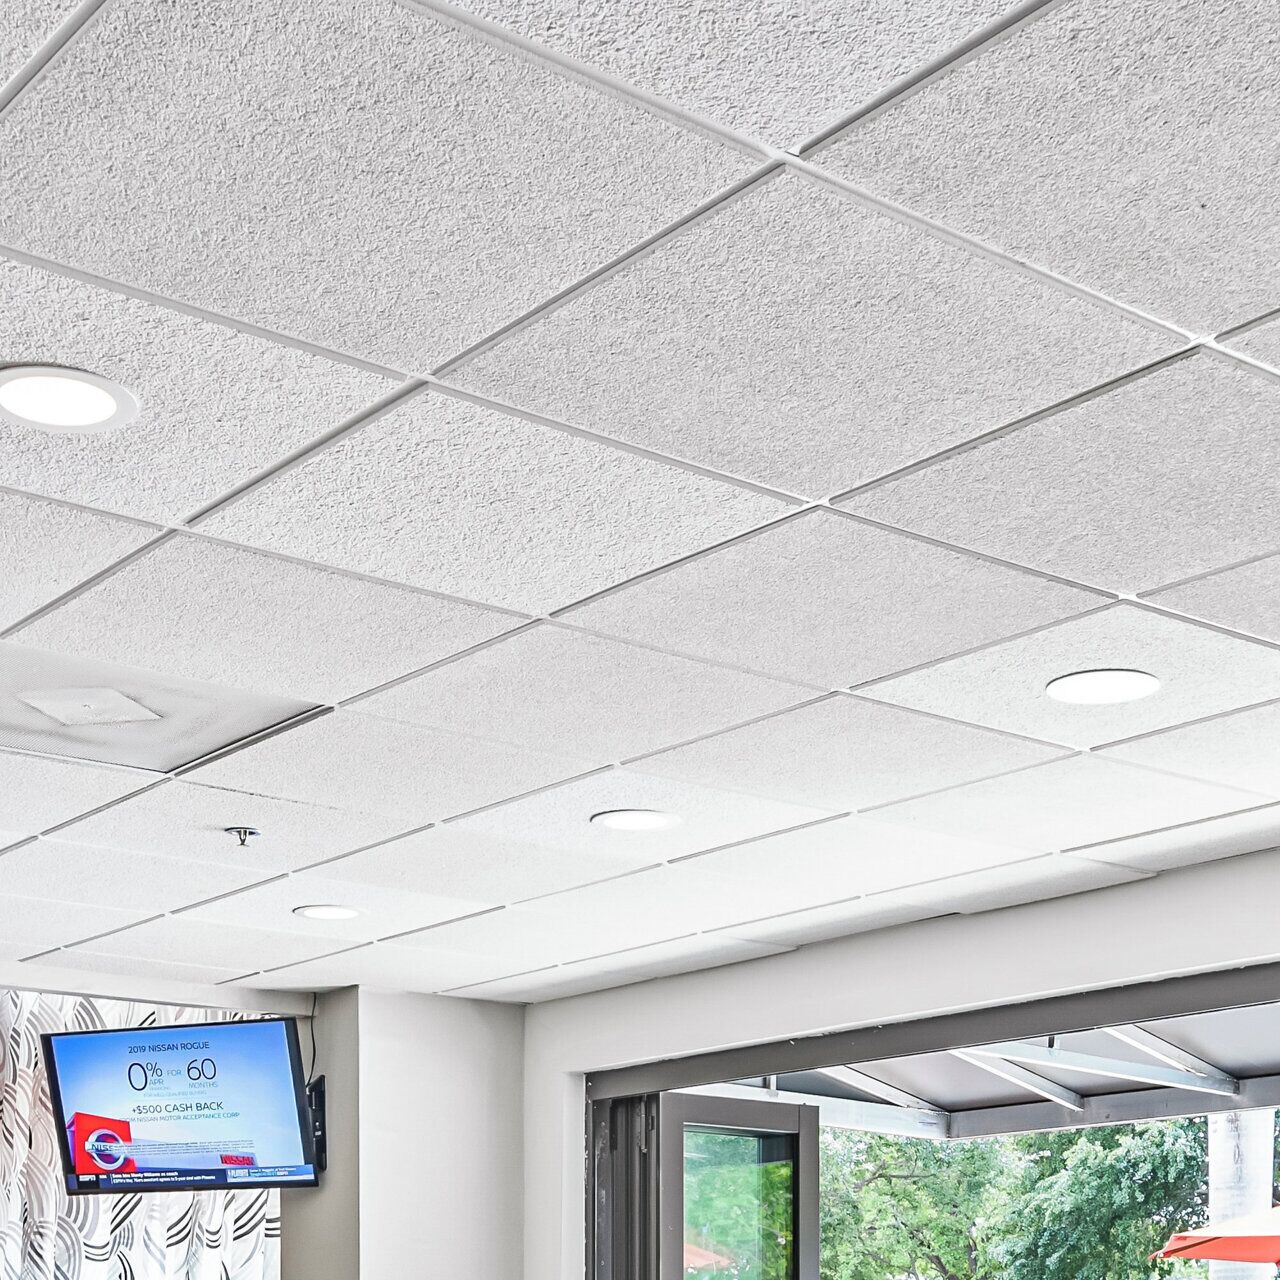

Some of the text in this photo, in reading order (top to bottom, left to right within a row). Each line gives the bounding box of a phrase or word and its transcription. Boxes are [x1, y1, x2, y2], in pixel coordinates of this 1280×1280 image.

[128, 1041, 210, 1054] 2019 NISSAN ROGUE
[128, 1058, 217, 1091] 0% FOR 60
[188, 1081, 218, 1089] MONTHS
[132, 1101, 224, 1115] +$500 CASH BACK
